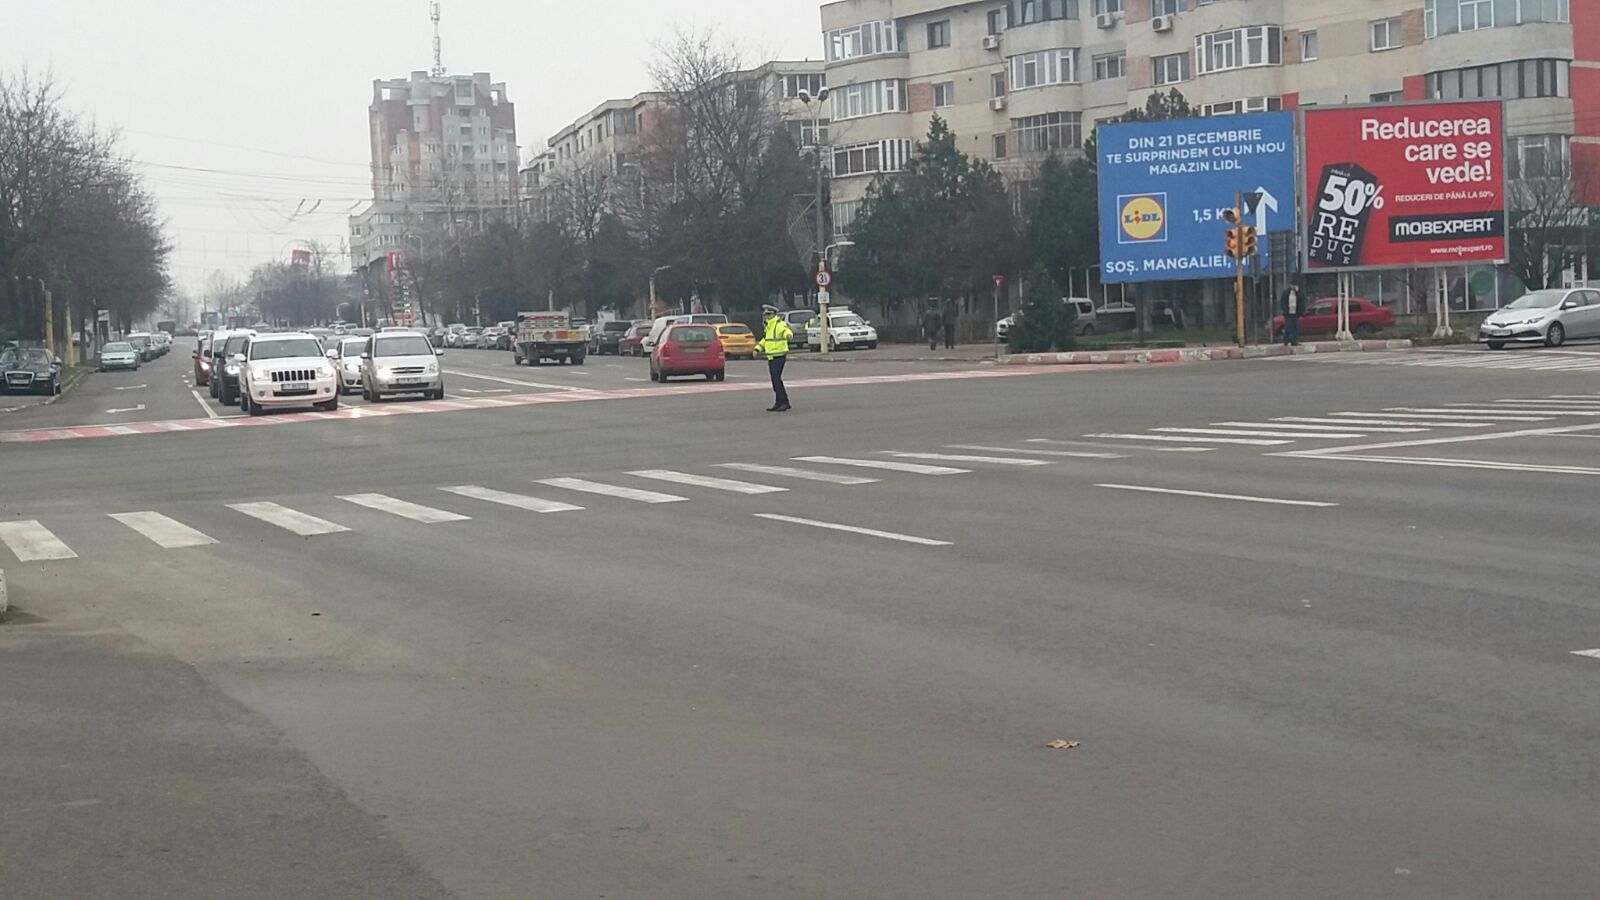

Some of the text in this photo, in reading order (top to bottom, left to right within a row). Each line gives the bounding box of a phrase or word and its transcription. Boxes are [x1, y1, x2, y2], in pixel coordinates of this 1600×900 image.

[1129, 129, 1262, 149] DIN 21 DECEMBRIE
[1361, 117, 1491, 141] Reducerea
[1106, 142, 1286, 164] TE SURPRINDEM CU UN NOU
[1405, 140, 1492, 162] care se
[1149, 160, 1242, 175] MAGAZIN LIDL
[1426, 159, 1492, 184] vede!
[1319, 174, 1385, 216] 50%
[1395, 193, 1433, 202] REDUCERI
[1467, 191, 1478, 199] LA
[1193, 207, 1232, 223] 1,5 K
[1395, 217, 1494, 236] MOBEXPERT
[1143, 255, 1231, 271] MANGALIEI,
